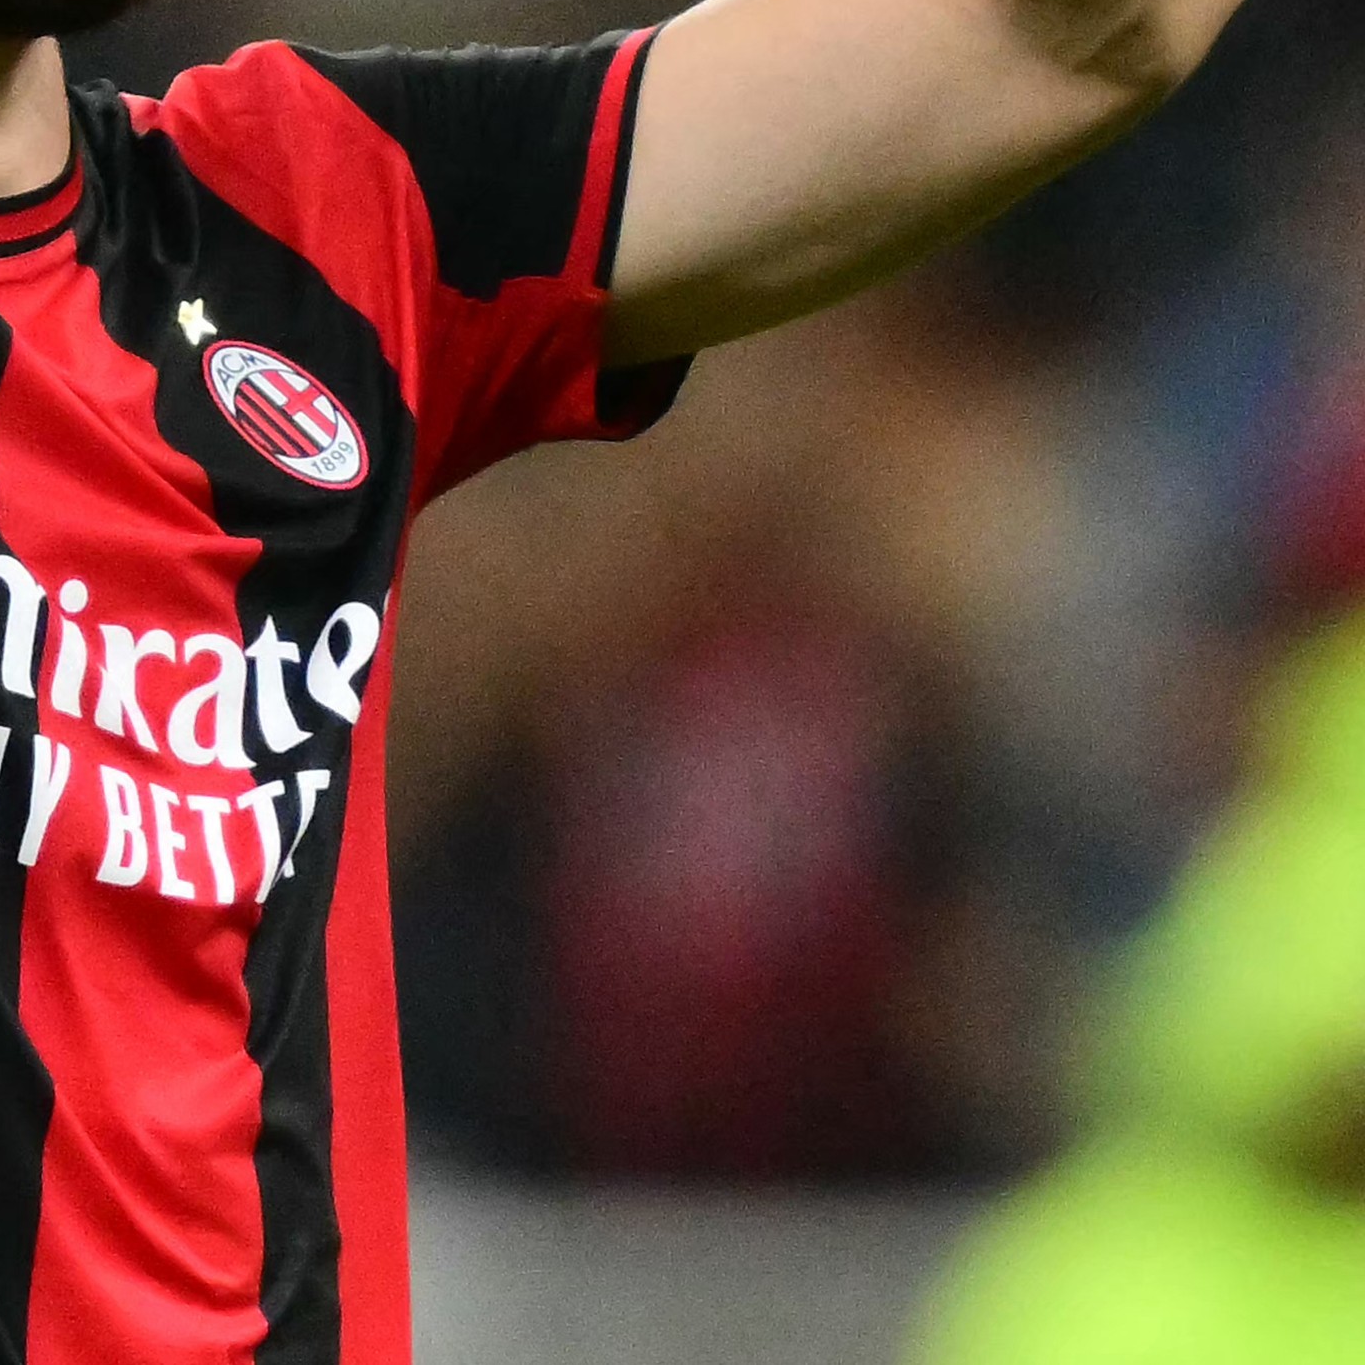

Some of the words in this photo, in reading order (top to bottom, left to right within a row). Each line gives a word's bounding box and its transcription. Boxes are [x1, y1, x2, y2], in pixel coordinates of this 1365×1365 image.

[216, 351, 268, 393] ACM
[310, 440, 354, 474] 1899
[95, 764, 332, 905] BETT
